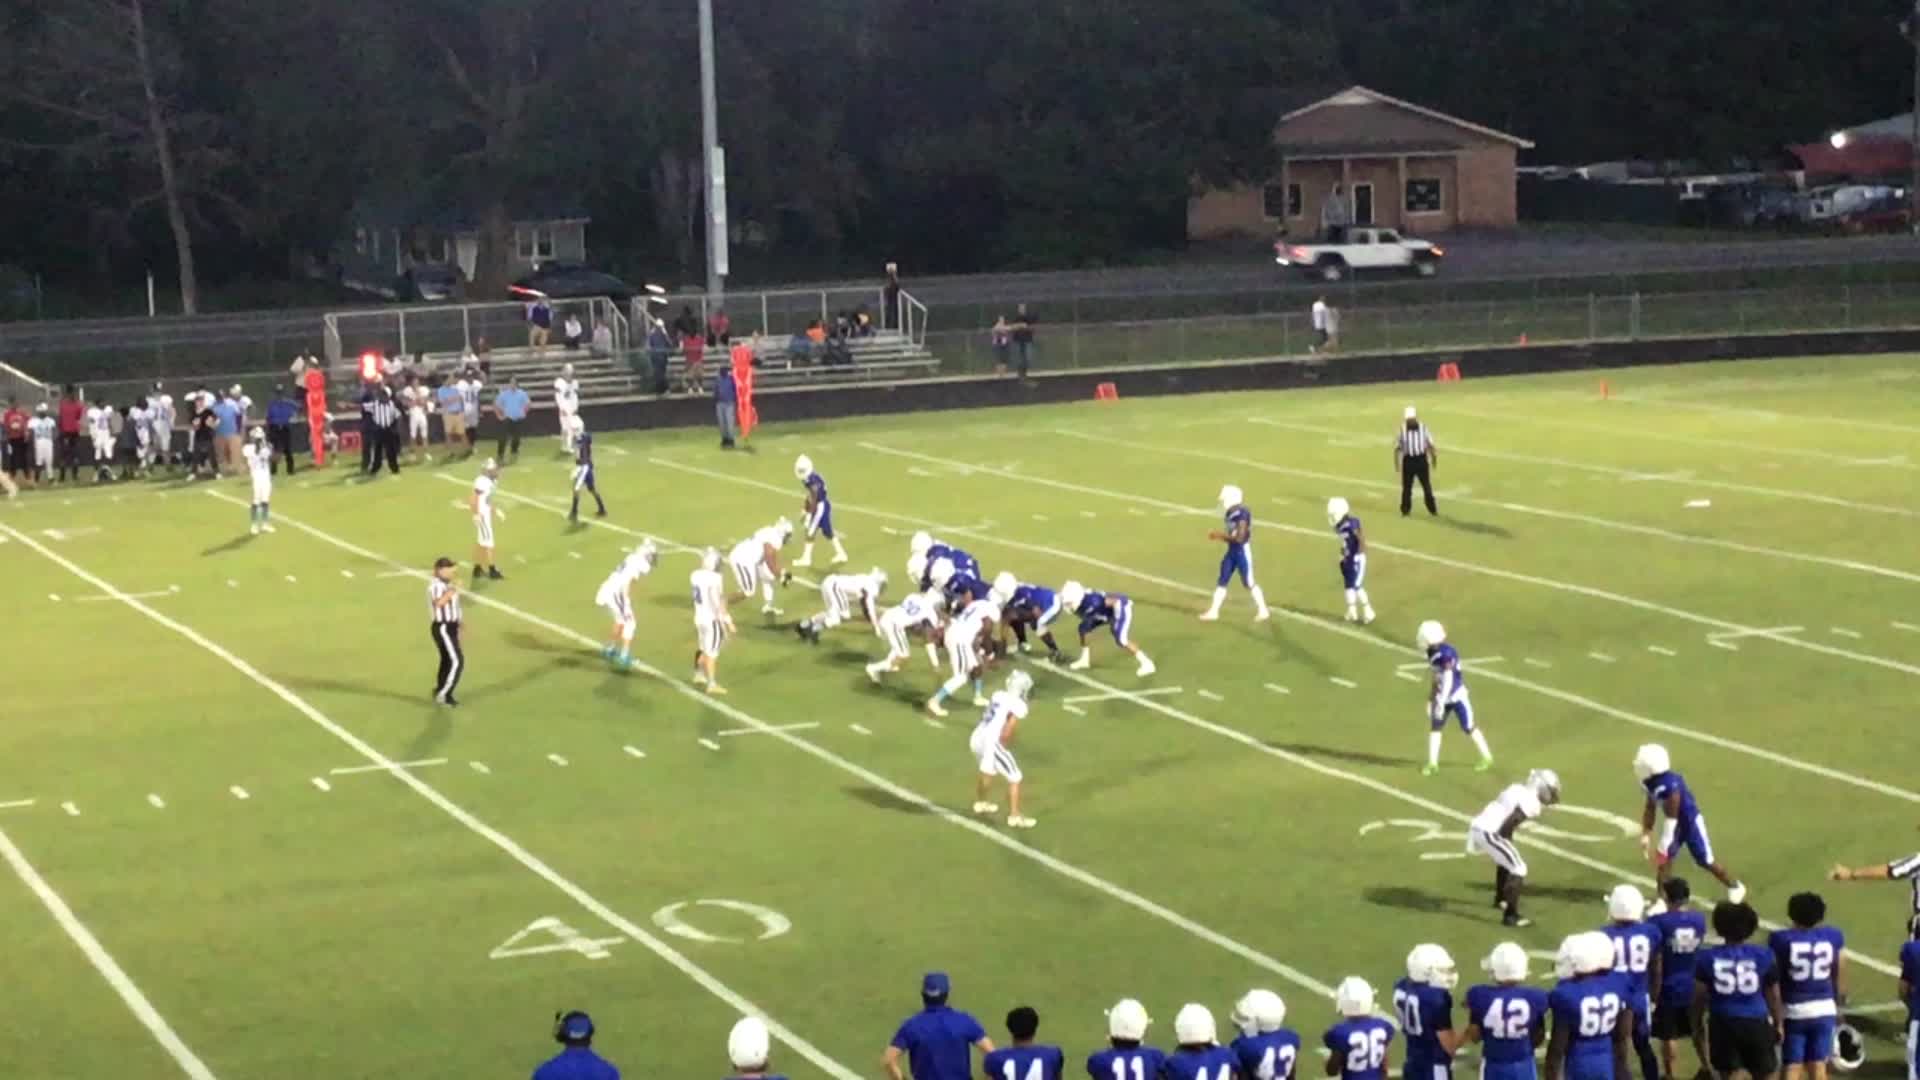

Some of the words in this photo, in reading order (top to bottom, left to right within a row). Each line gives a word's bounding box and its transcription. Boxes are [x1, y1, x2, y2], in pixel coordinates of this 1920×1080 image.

[489, 898, 792, 959] 40
[1613, 934, 1650, 973] 18
[1789, 940, 1834, 981] 52
[1713, 957, 1759, 994] 56
[1484, 997, 1530, 1039] 42
[1580, 992, 1619, 1036] 62
[1347, 1028, 1387, 1072] 26
